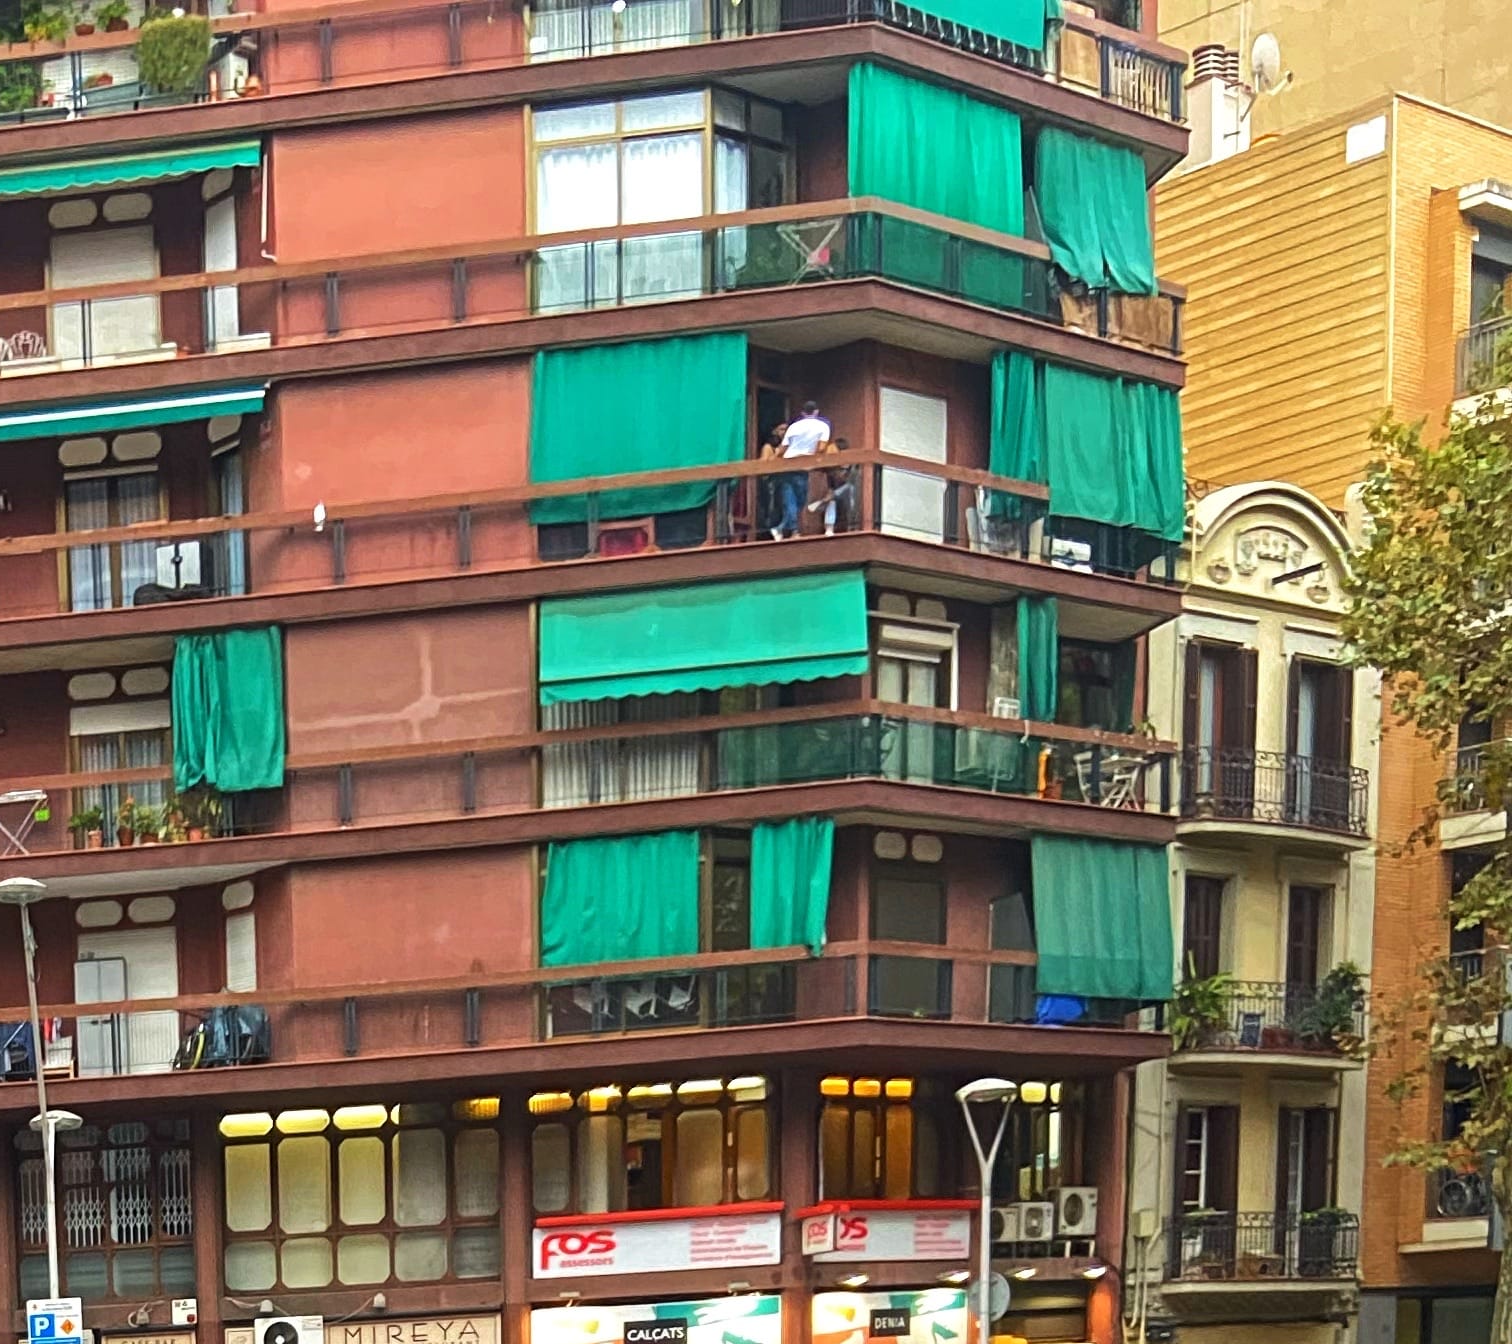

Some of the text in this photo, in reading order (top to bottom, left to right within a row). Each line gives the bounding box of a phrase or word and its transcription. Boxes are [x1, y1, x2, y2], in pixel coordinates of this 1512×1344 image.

[34, 1316, 50, 1337] P
[874, 1316, 906, 1330] DENIA
[626, 1326, 686, 1343] CALÇATS
